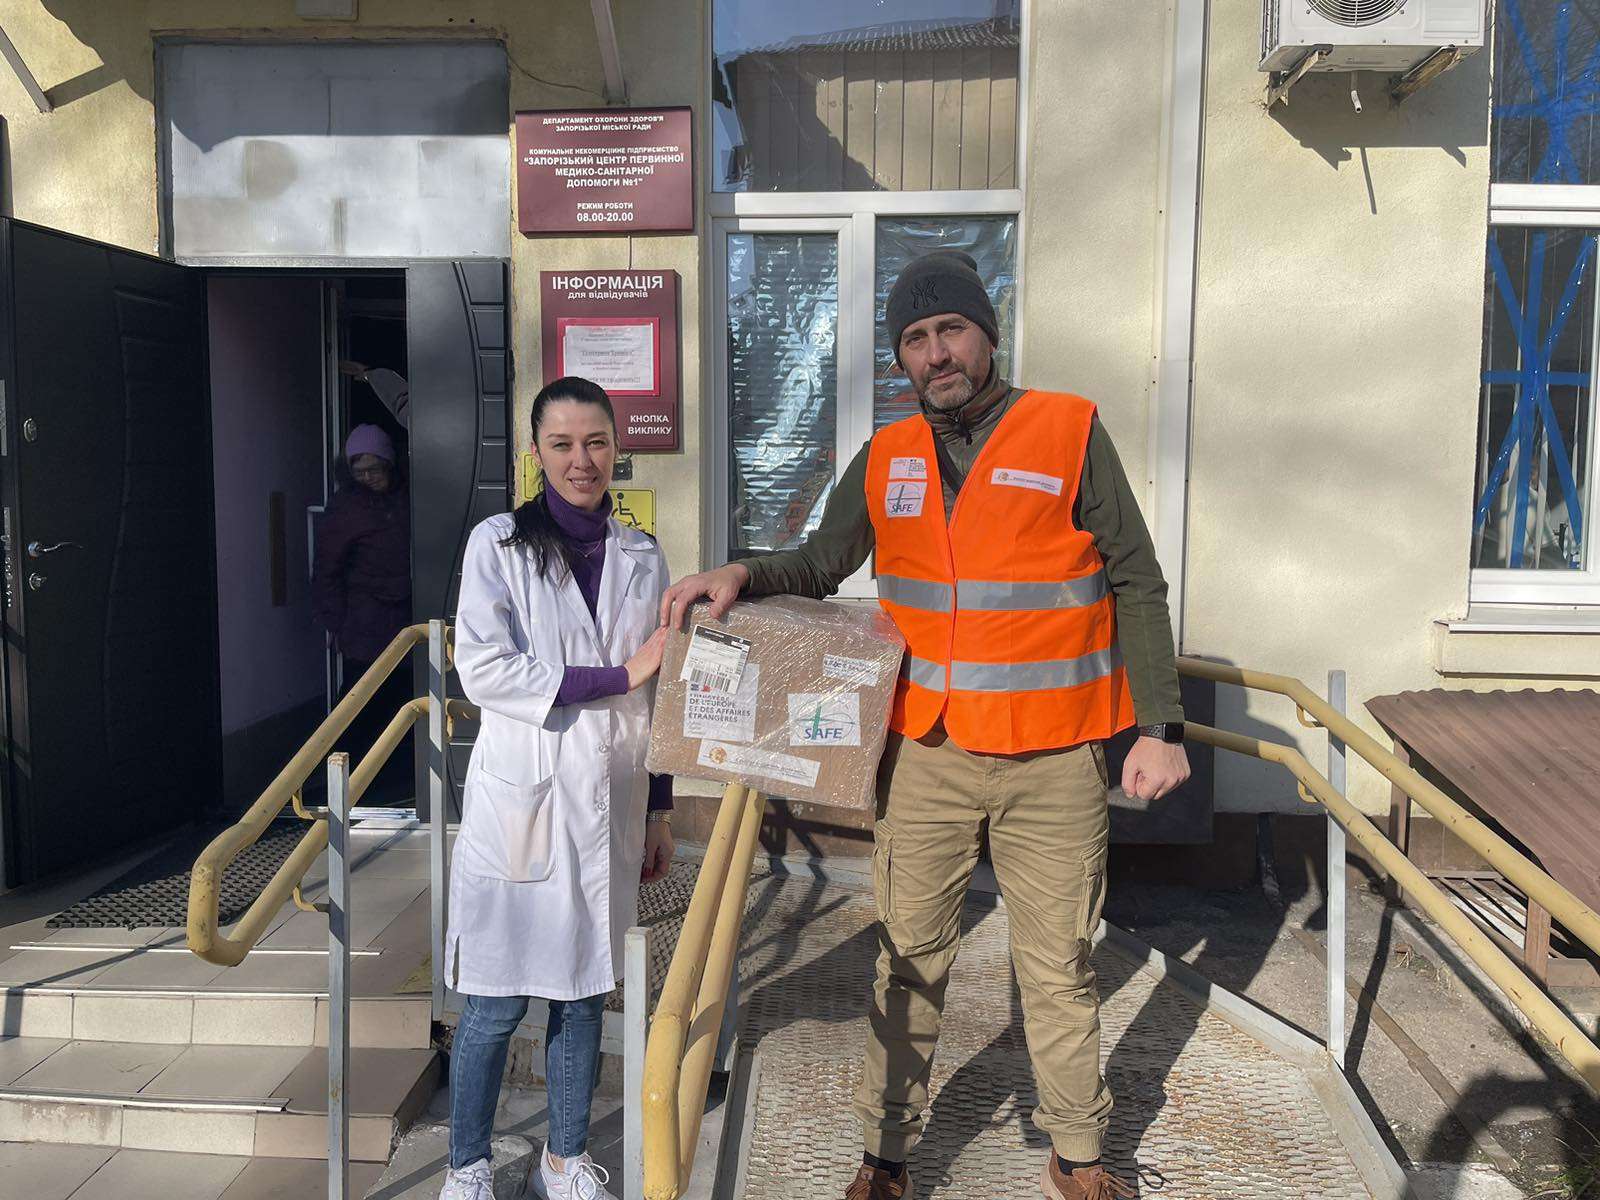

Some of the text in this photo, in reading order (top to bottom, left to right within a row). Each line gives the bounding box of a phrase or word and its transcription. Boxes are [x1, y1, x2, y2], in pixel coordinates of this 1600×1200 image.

[627, 146, 679, 154] ПІДПРИЄМСТВО
[596, 156, 627, 165] ЦЕНТР
[629, 153, 684, 164] ПЕРВИННОЇ
[555, 166, 653, 177] МЕДИКО-САНІТАРНОЇ
[567, 178, 620, 188] ДОПОМОГИ
[576, 212, 634, 222] 08.00-20.00
[552, 276, 663, 292] ІНФОРМАЦІЯ
[568, 290, 648, 299] для відвідувачів
[630, 415, 669, 423] КНОПКА
[628, 426, 672, 435] ВИКЛИКУ
[891, 503, 914, 513] SAFE
[715, 708, 751, 716] AFFAIRES
[804, 728, 843, 740] SAFE
